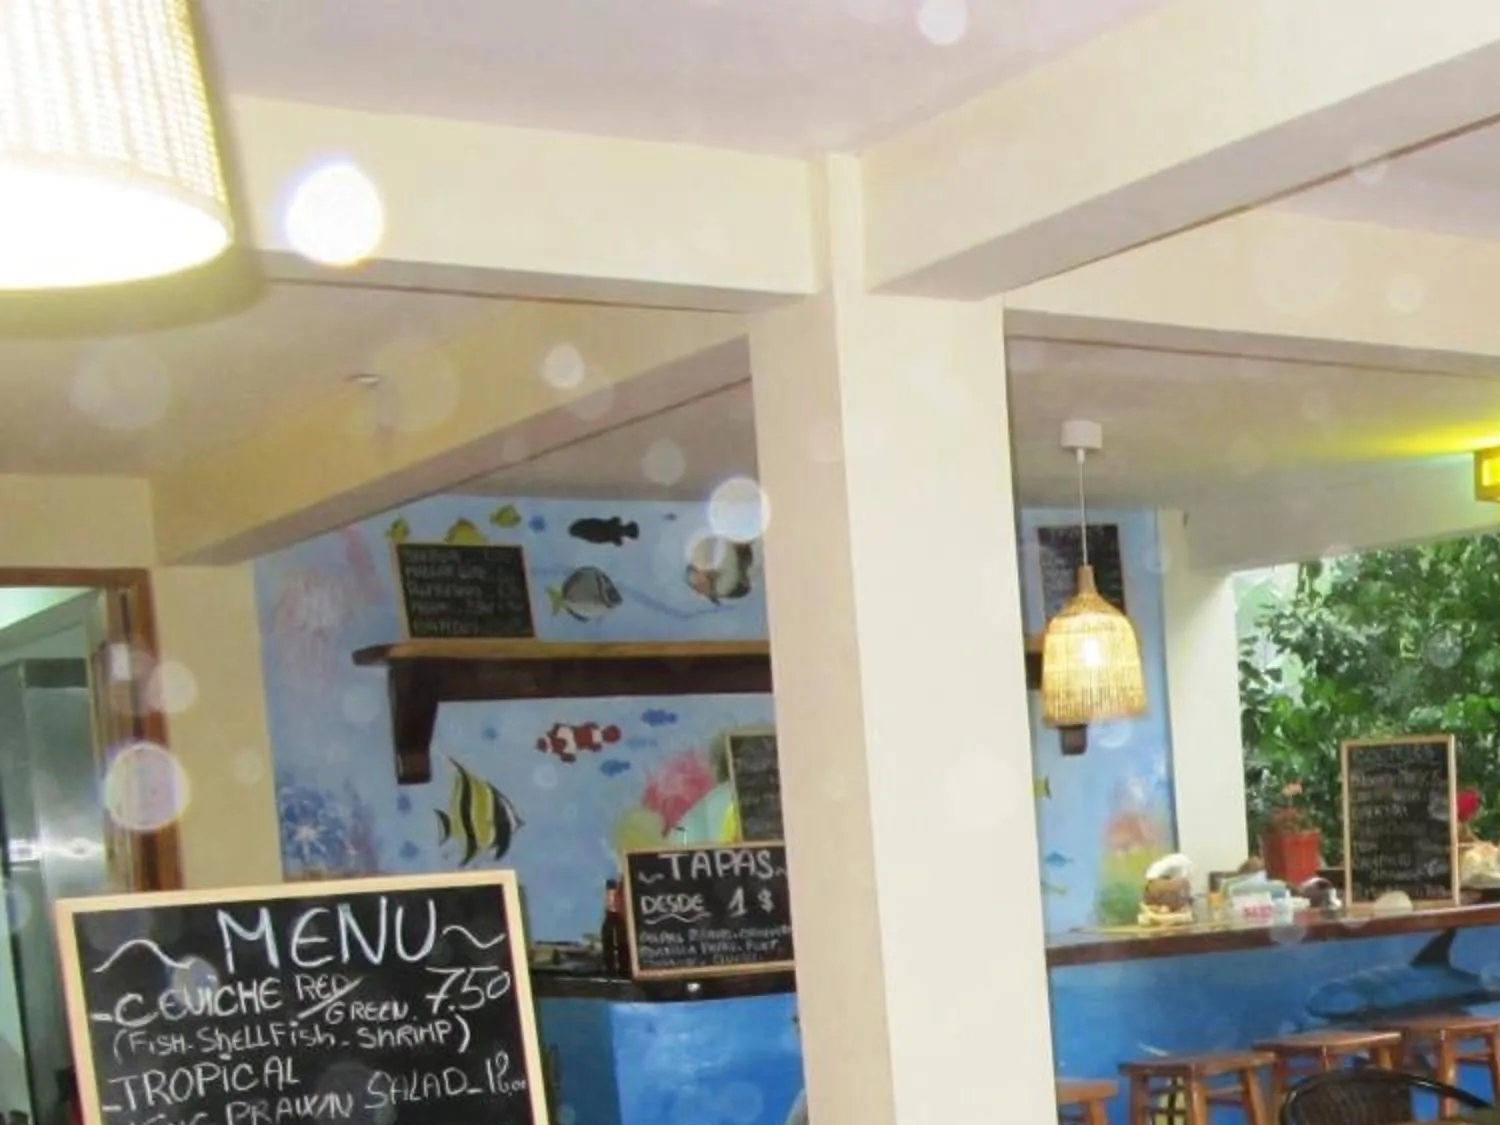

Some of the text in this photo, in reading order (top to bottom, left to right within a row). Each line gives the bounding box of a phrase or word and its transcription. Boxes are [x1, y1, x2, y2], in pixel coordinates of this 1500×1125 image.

[658, 850, 774, 880] TAPAS
[641, 894, 705, 914] DESDE
[217, 896, 436, 973] MENU
